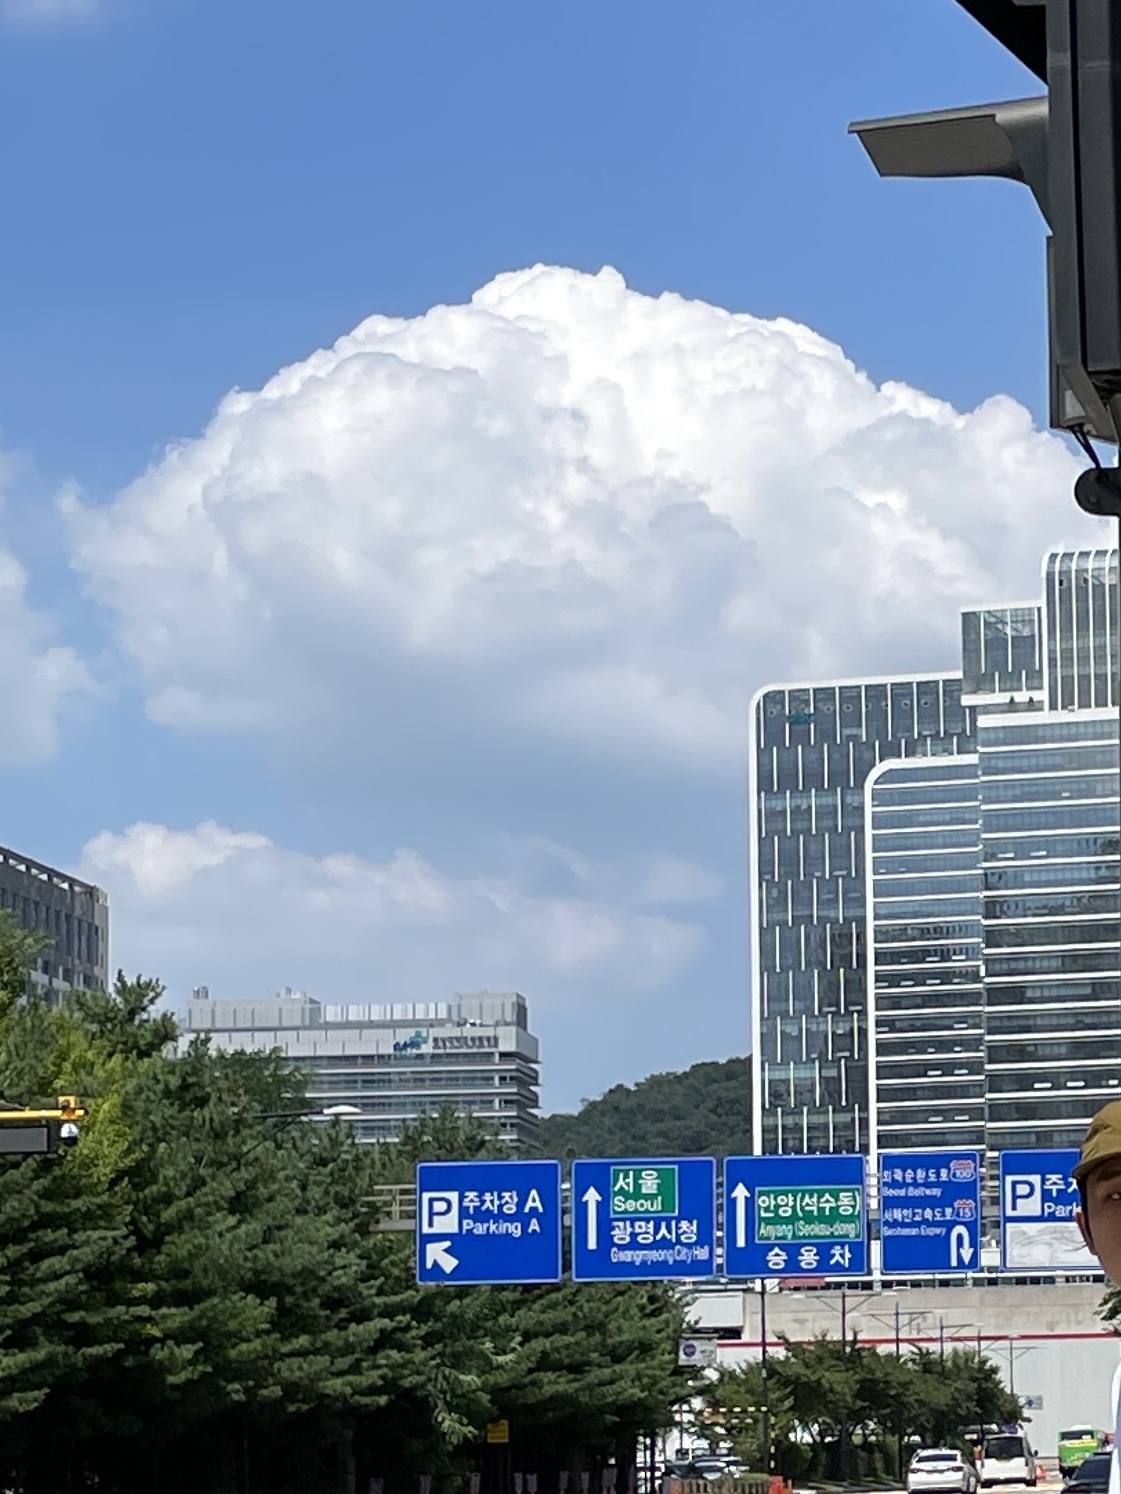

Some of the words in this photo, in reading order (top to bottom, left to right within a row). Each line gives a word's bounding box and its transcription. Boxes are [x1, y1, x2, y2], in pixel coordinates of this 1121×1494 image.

[613, 1170, 661, 1194] 서울
[462, 1190, 519, 1215] 주차장
[523, 1188, 544, 1213] A
[613, 1195, 662, 1212] Seoul
[758, 1190, 860, 1218] 안양(석수동)
[462, 1219, 521, 1238] Parking
[527, 1217, 541, 1234] A
[610, 1219, 698, 1245] 광명시청
[692, 1245, 710, 1260] Hall
